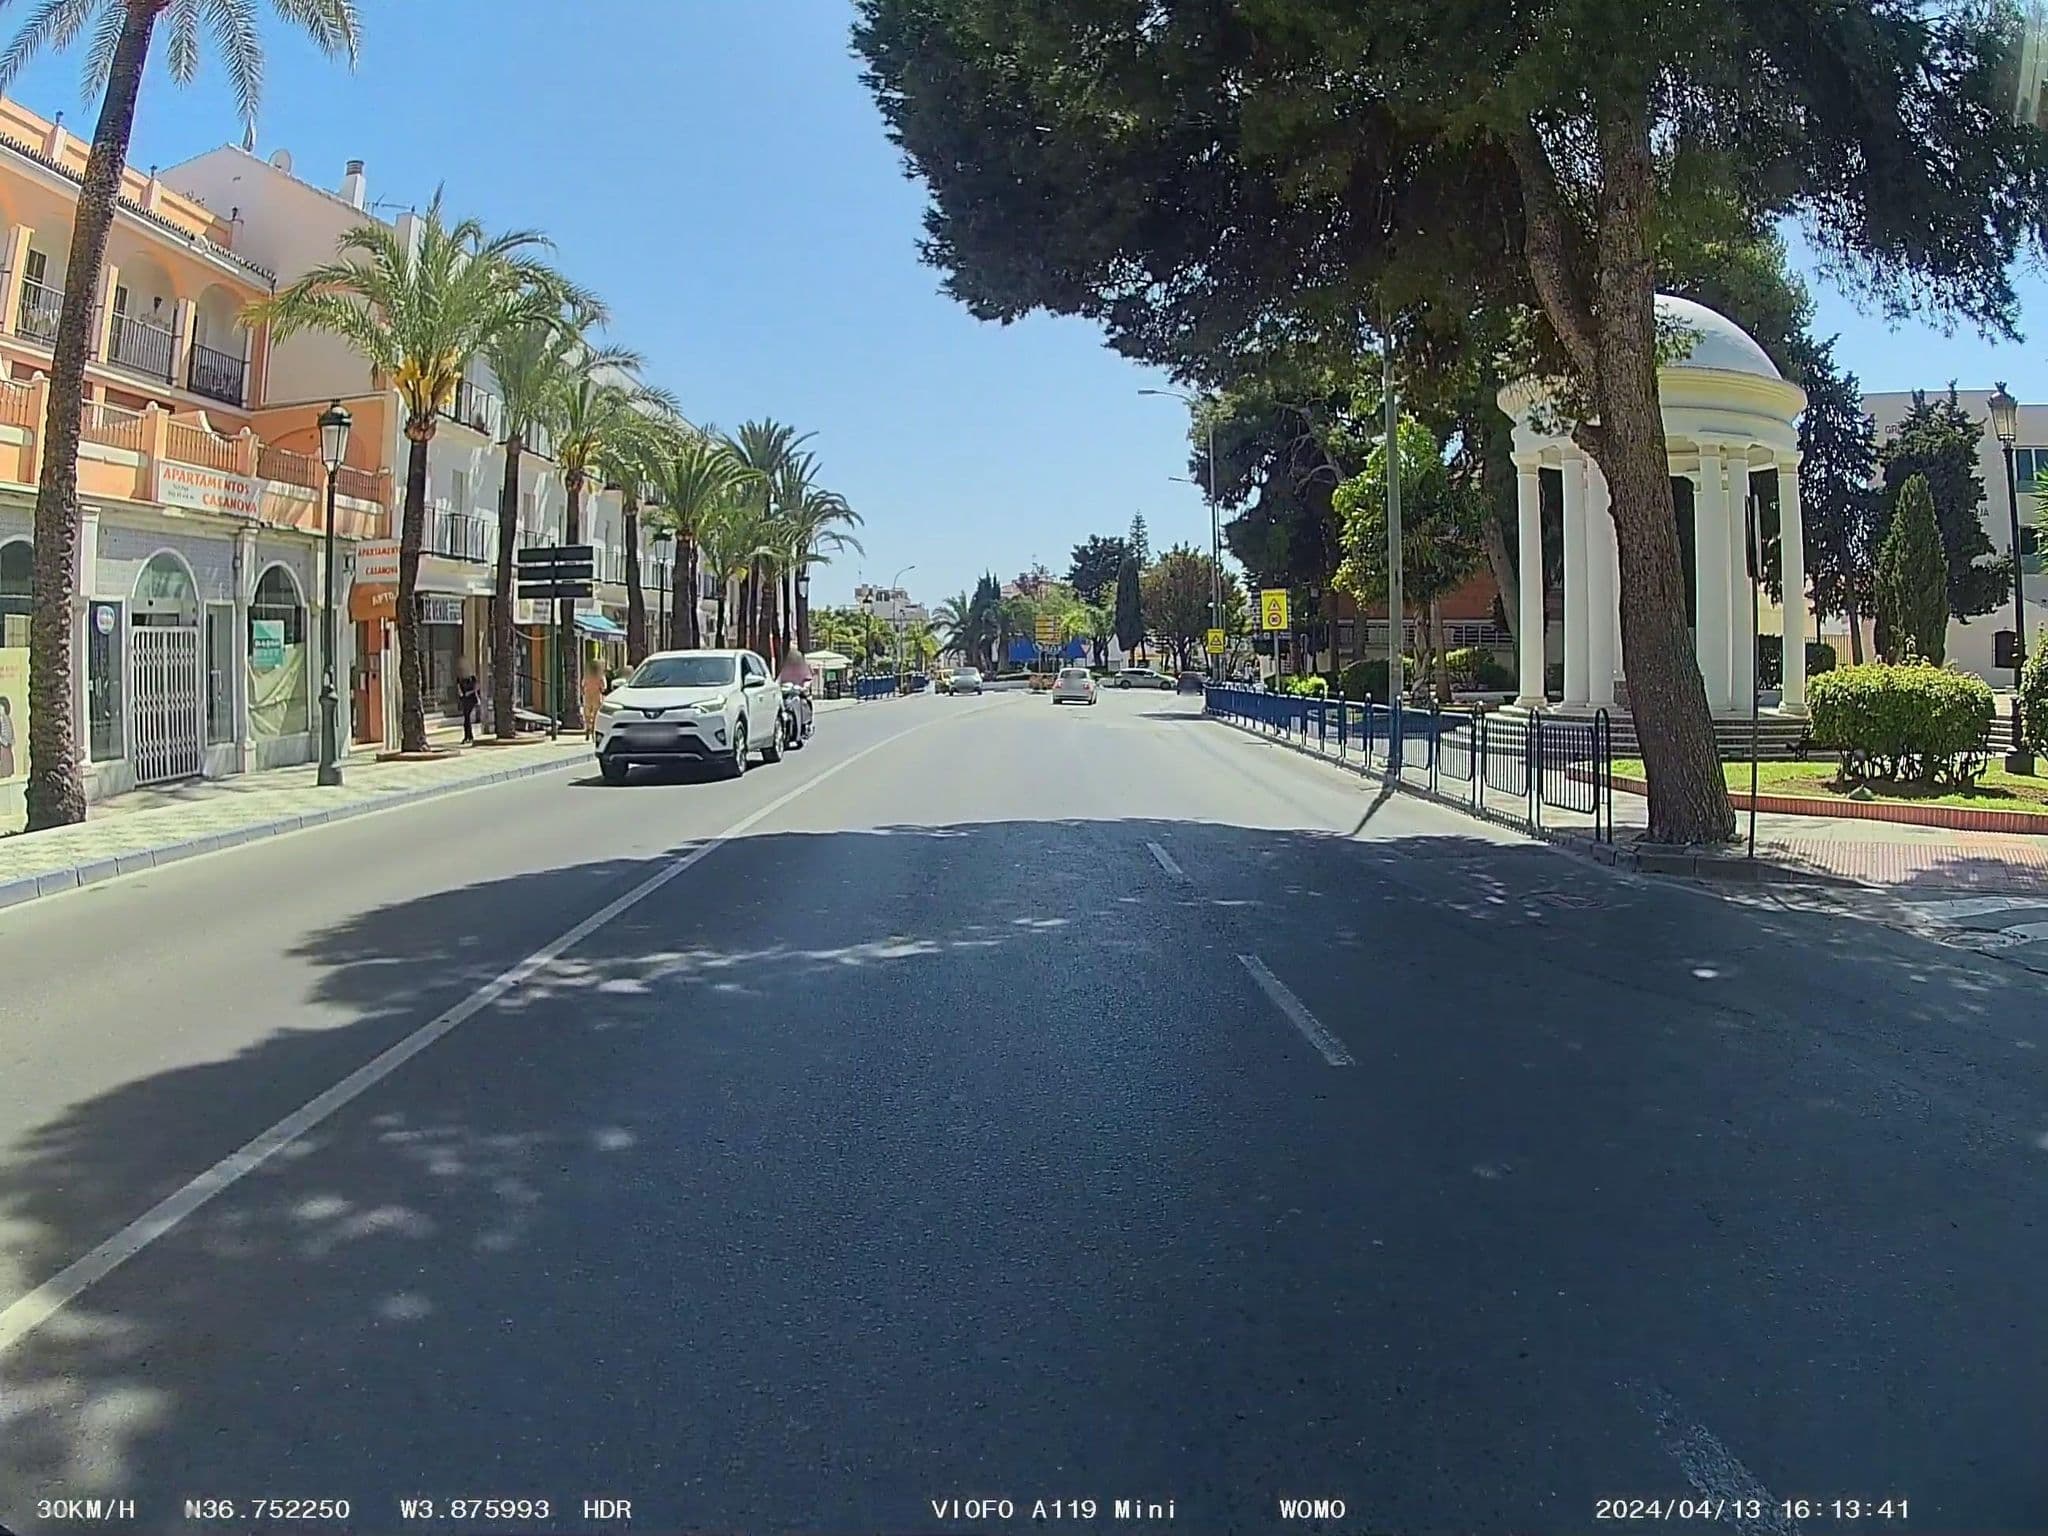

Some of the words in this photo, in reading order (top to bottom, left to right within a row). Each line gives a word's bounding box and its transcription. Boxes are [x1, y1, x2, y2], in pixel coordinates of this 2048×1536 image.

[163, 467, 250, 495] APARTAMENTOS
[202, 493, 257, 514] CASANOVA
[358, 546, 399, 557] APARTAMENT
